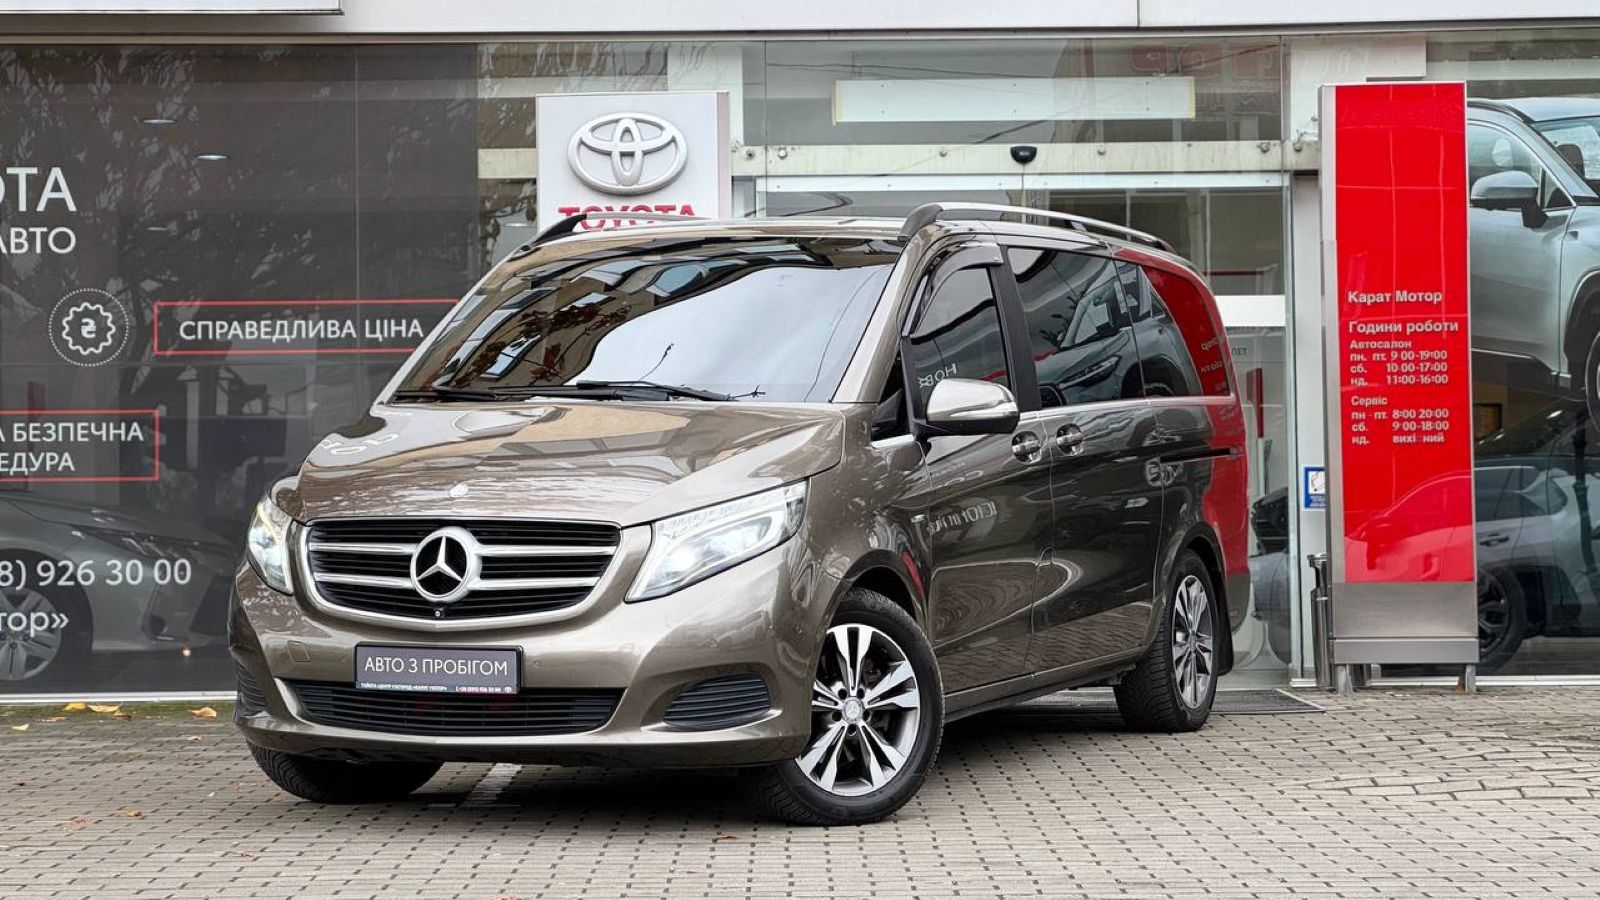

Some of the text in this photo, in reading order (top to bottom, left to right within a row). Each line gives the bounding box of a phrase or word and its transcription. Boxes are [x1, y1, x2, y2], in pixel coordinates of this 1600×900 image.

[0, 227, 76, 254] ВТО
[1348, 291, 1443, 305] Карат Мотор
[180, 319, 424, 342] СПРАВЕДЛИВА ЦІНА
[1349, 321, 1458, 334] Години роботи
[1349, 340, 1412, 350] Автосалон
[1351, 396, 1387, 407] Сервіс
[14, 422, 143, 441] БЕЗПЕЧНА
[1393, 433, 1444, 443] вихіний
[0, 452, 75, 475] ЕДУРА
[37, 560, 95, 586] 926
[106, 560, 143, 585] 30
[154, 559, 191, 584] 00
[364, 657, 508, 676] АВТО З ПРОБІГОМ
